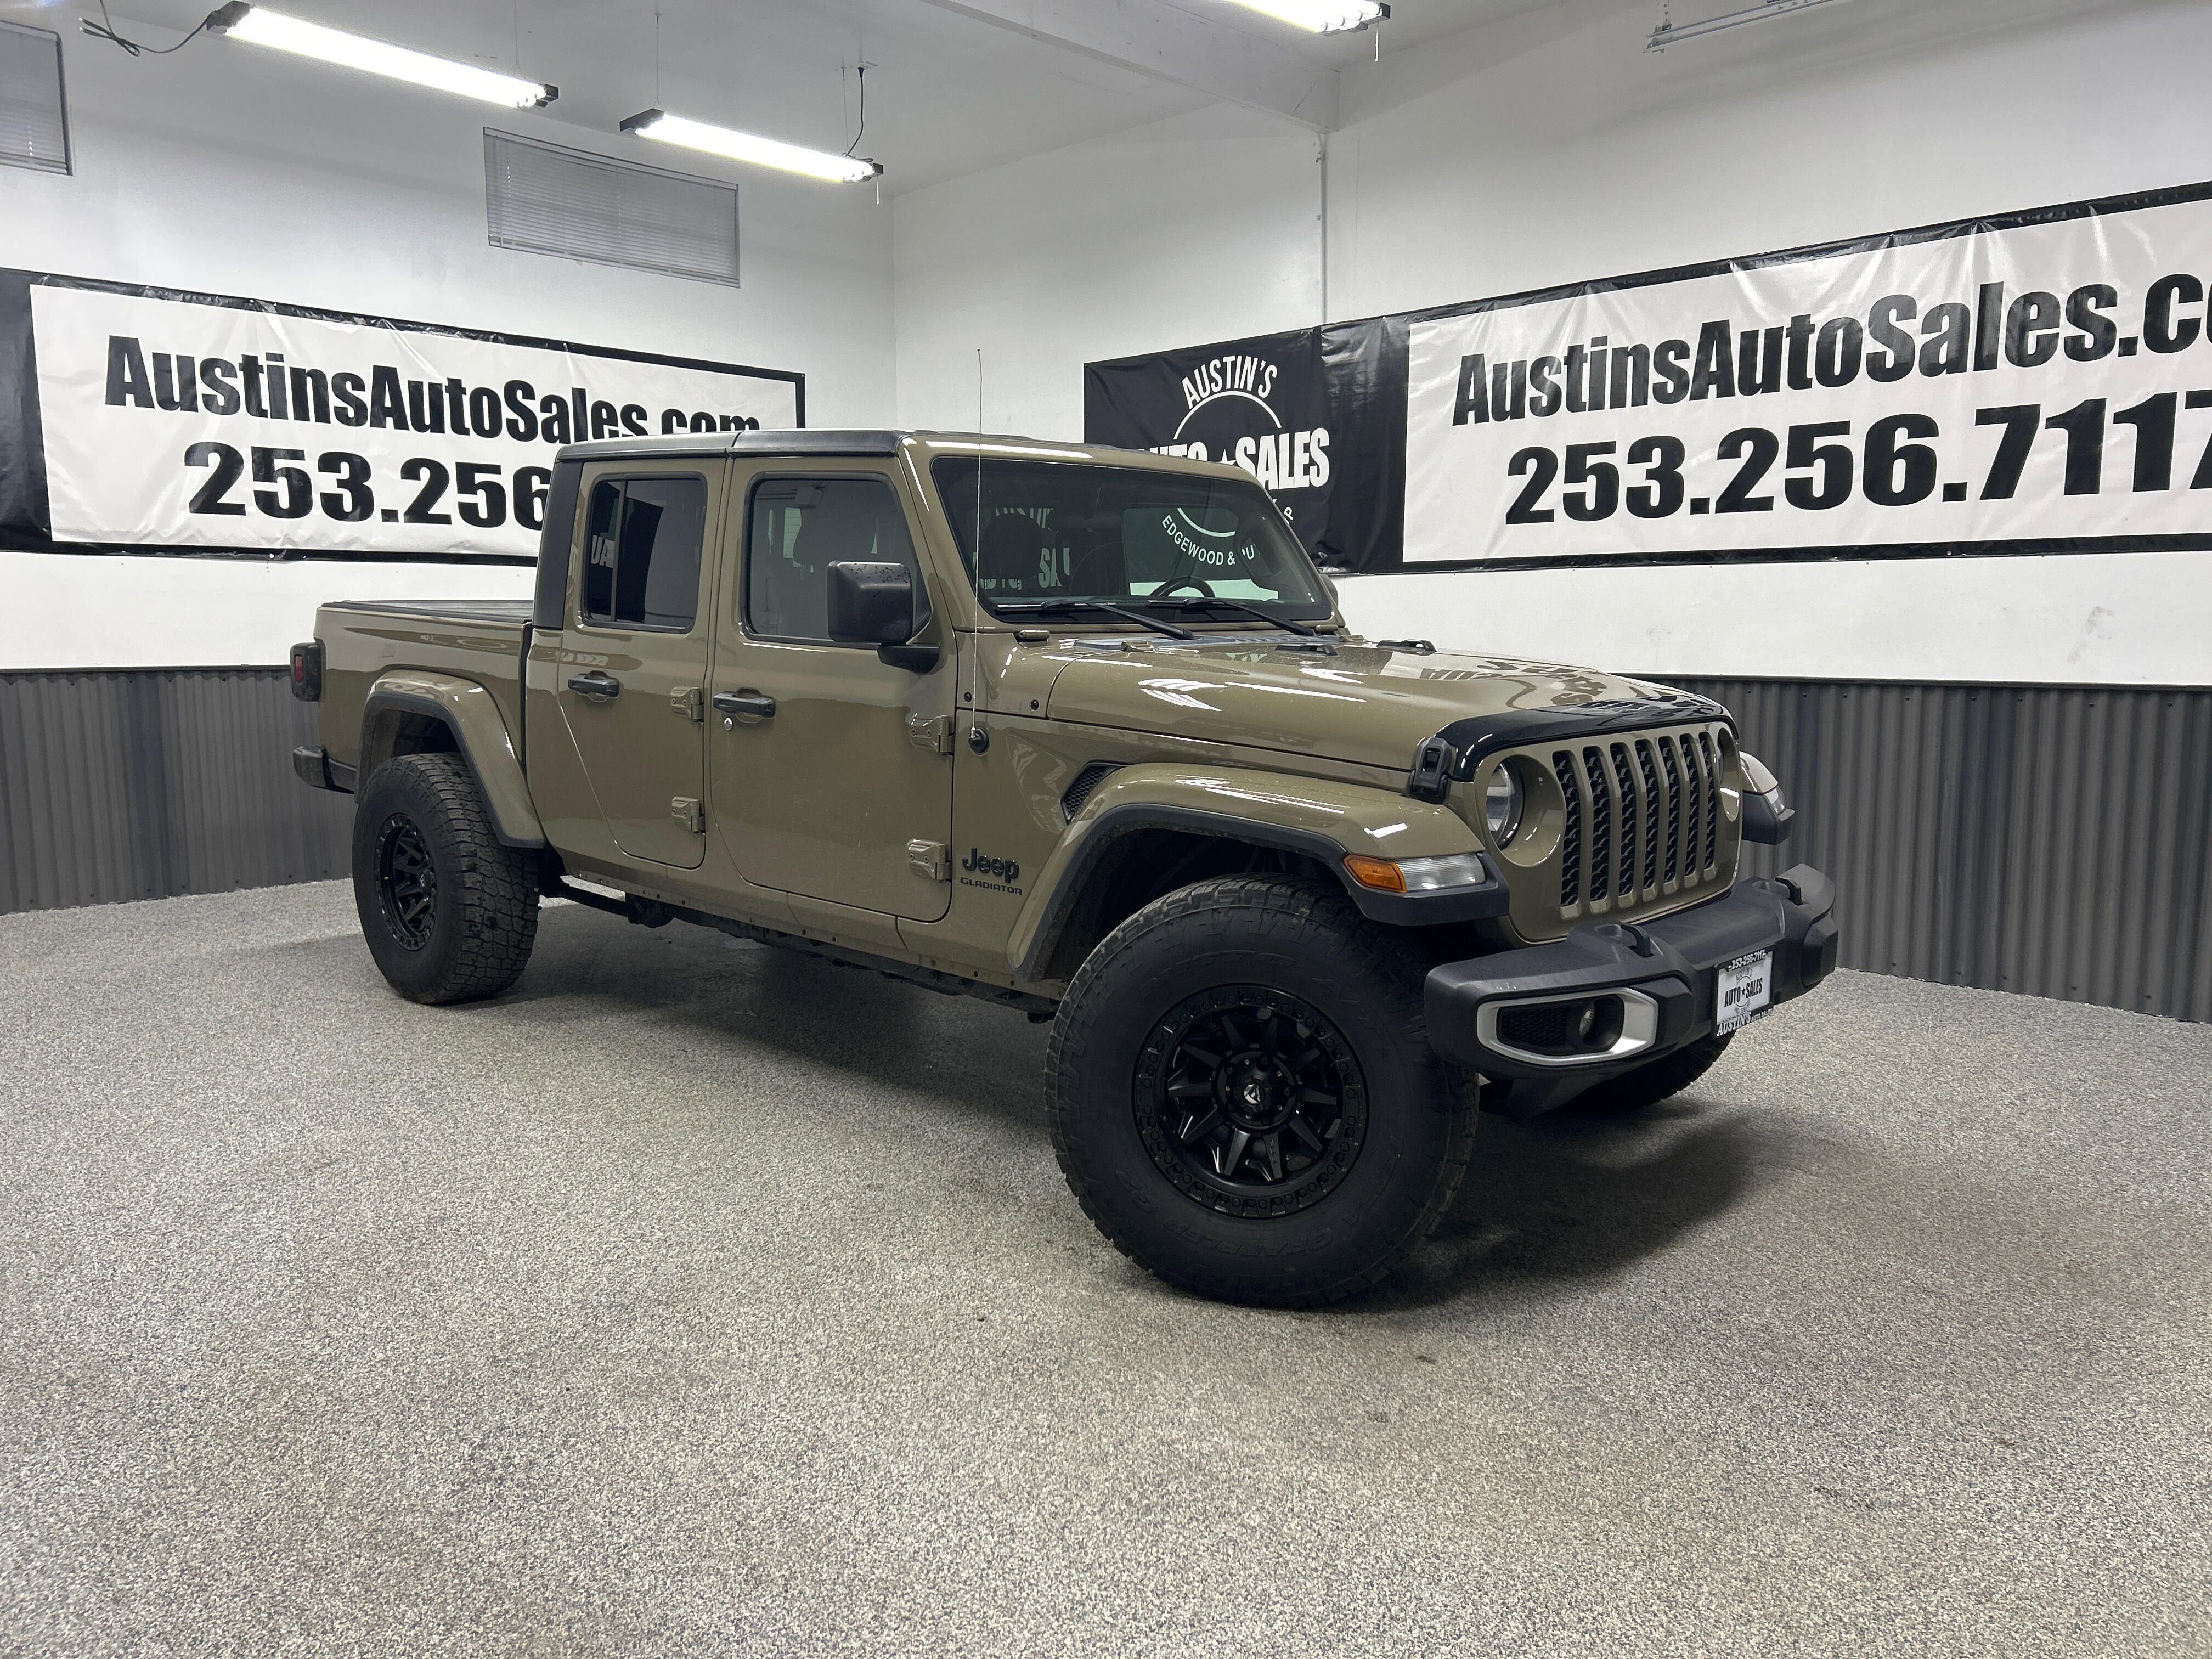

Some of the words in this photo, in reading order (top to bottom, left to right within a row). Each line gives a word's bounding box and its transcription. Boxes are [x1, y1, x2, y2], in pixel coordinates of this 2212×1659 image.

[1452, 273, 2212, 426] AustinsAutoSales.c
[105, 335, 760, 443] AustinsAutoSales
[1181, 355, 1277, 409] AUSTIN'S
[1234, 428, 1330, 490] SALES
[1161, 515, 1224, 566] EDGEWOOD
[1227, 551, 1235, 565] &
[961, 877, 1023, 895] GLADIATOR
[962, 848, 1019, 883] Jeep
[1724, 986, 1741, 1008] AUTO
[1746, 977, 1763, 999] SALES
[1717, 1011, 1751, 1037] AUSTIN'S
